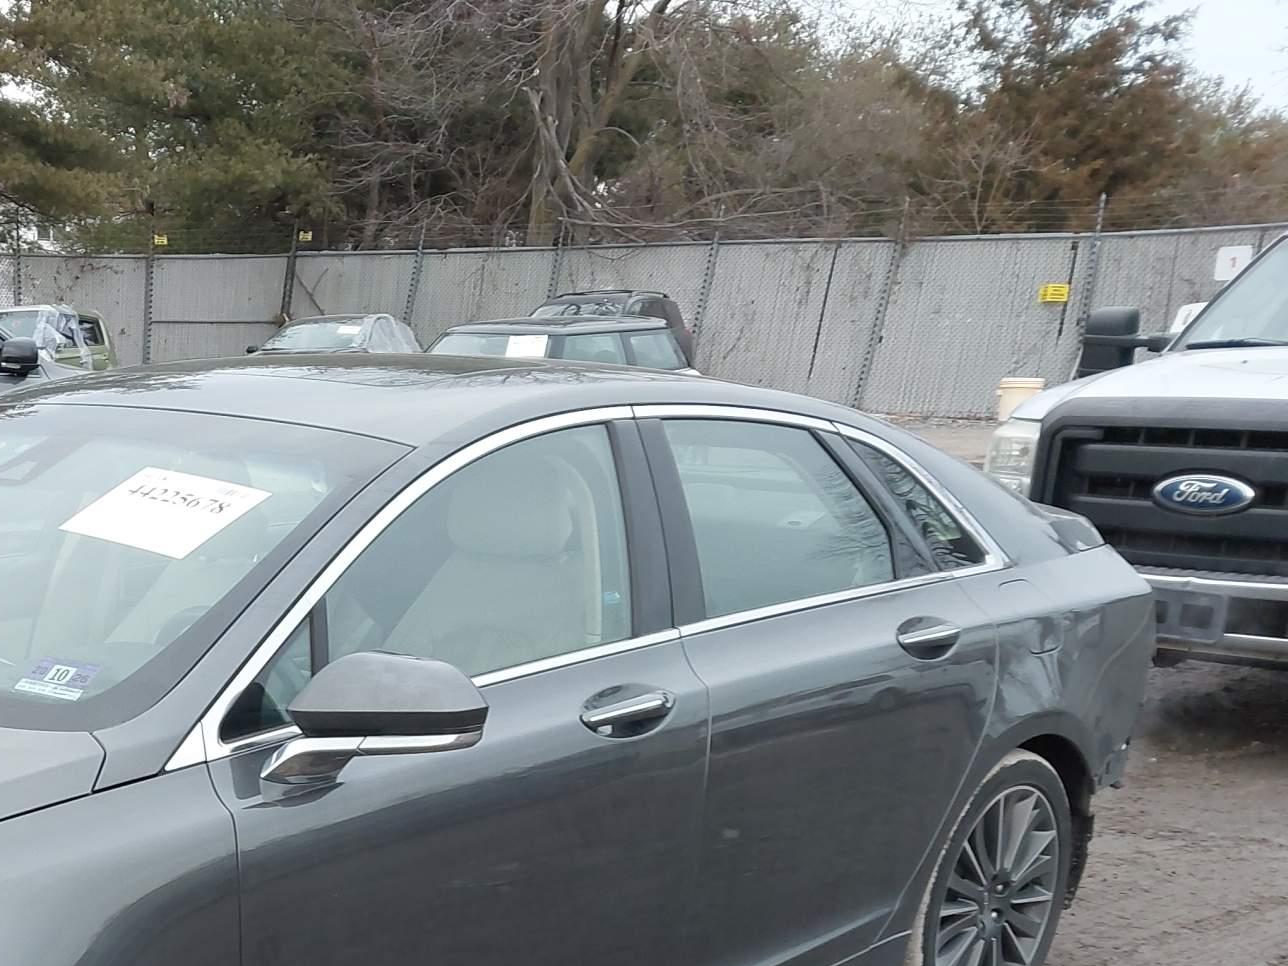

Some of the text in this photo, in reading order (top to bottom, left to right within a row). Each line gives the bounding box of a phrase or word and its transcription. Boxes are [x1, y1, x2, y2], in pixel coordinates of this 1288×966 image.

[1229, 256, 1238, 268] 1
[128, 484, 232, 514] 44225678
[1173, 480, 1230, 503] Ford
[48, 667, 70, 682] 10
